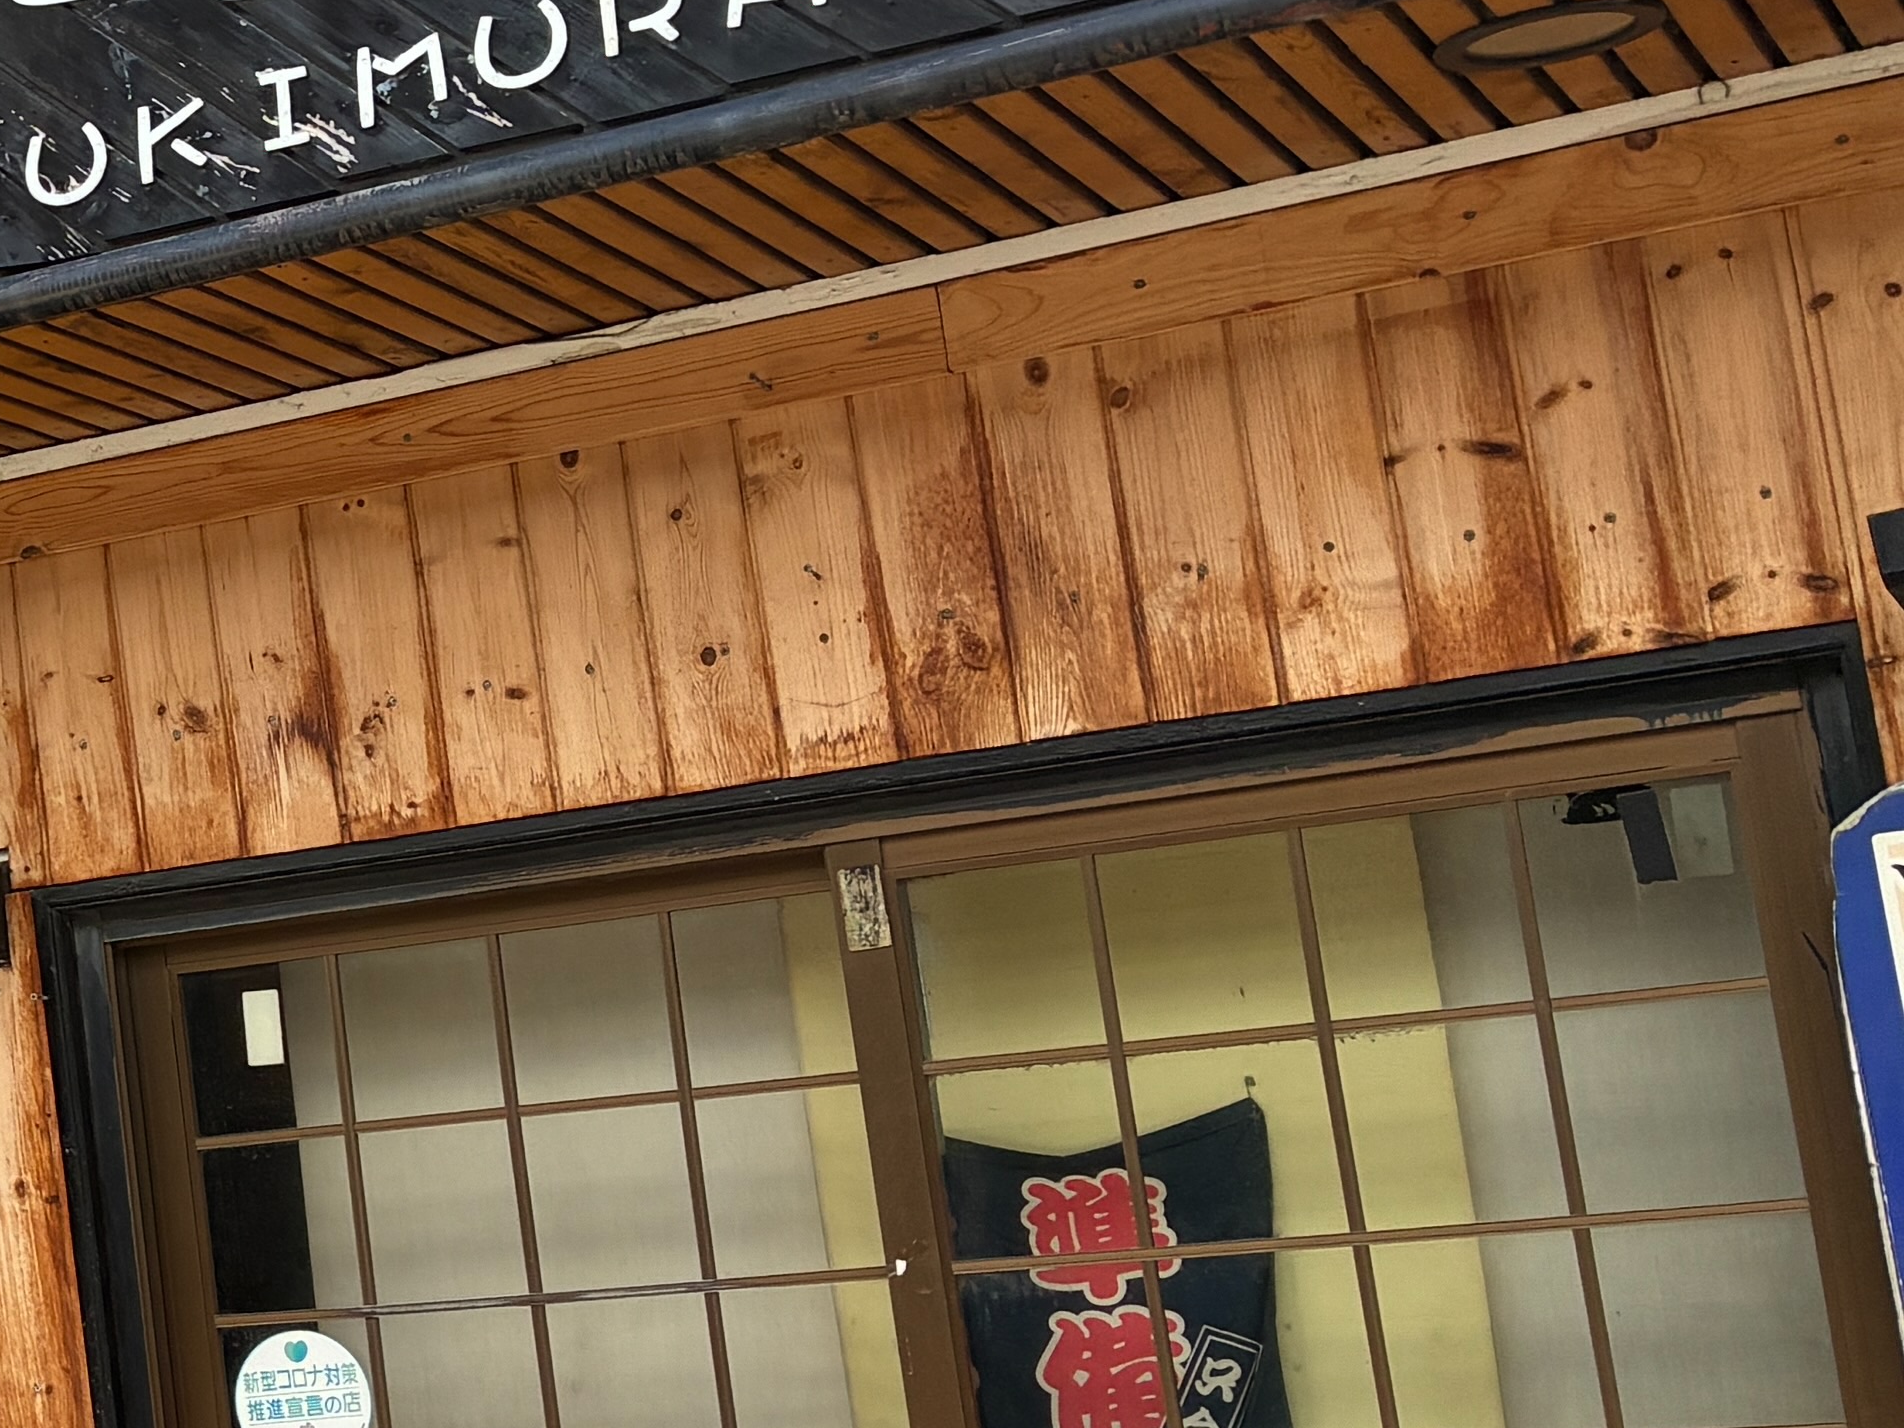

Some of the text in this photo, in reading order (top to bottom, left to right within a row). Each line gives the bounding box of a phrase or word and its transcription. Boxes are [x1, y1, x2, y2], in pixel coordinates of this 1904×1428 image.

[243, 1362, 359, 1394] 新型コロナ対策
[247, 1391, 362, 1421] 推進宣言の店
